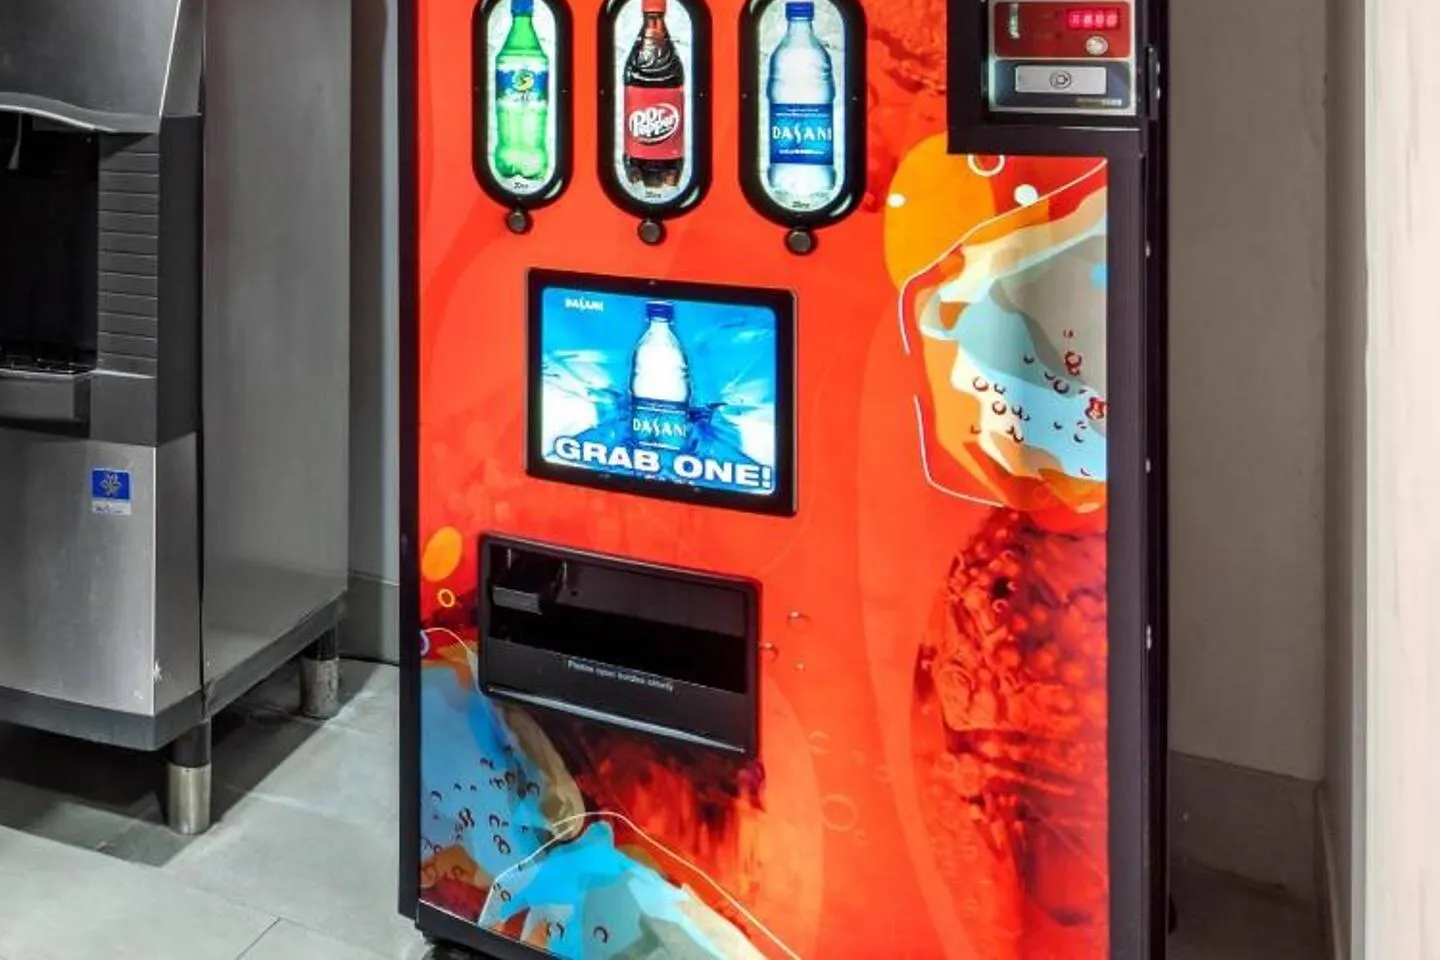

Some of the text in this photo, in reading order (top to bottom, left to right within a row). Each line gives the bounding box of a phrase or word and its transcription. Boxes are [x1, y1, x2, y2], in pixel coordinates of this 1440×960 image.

[772, 123, 832, 144] DASANI
[554, 436, 772, 489] GRAB ONE!
